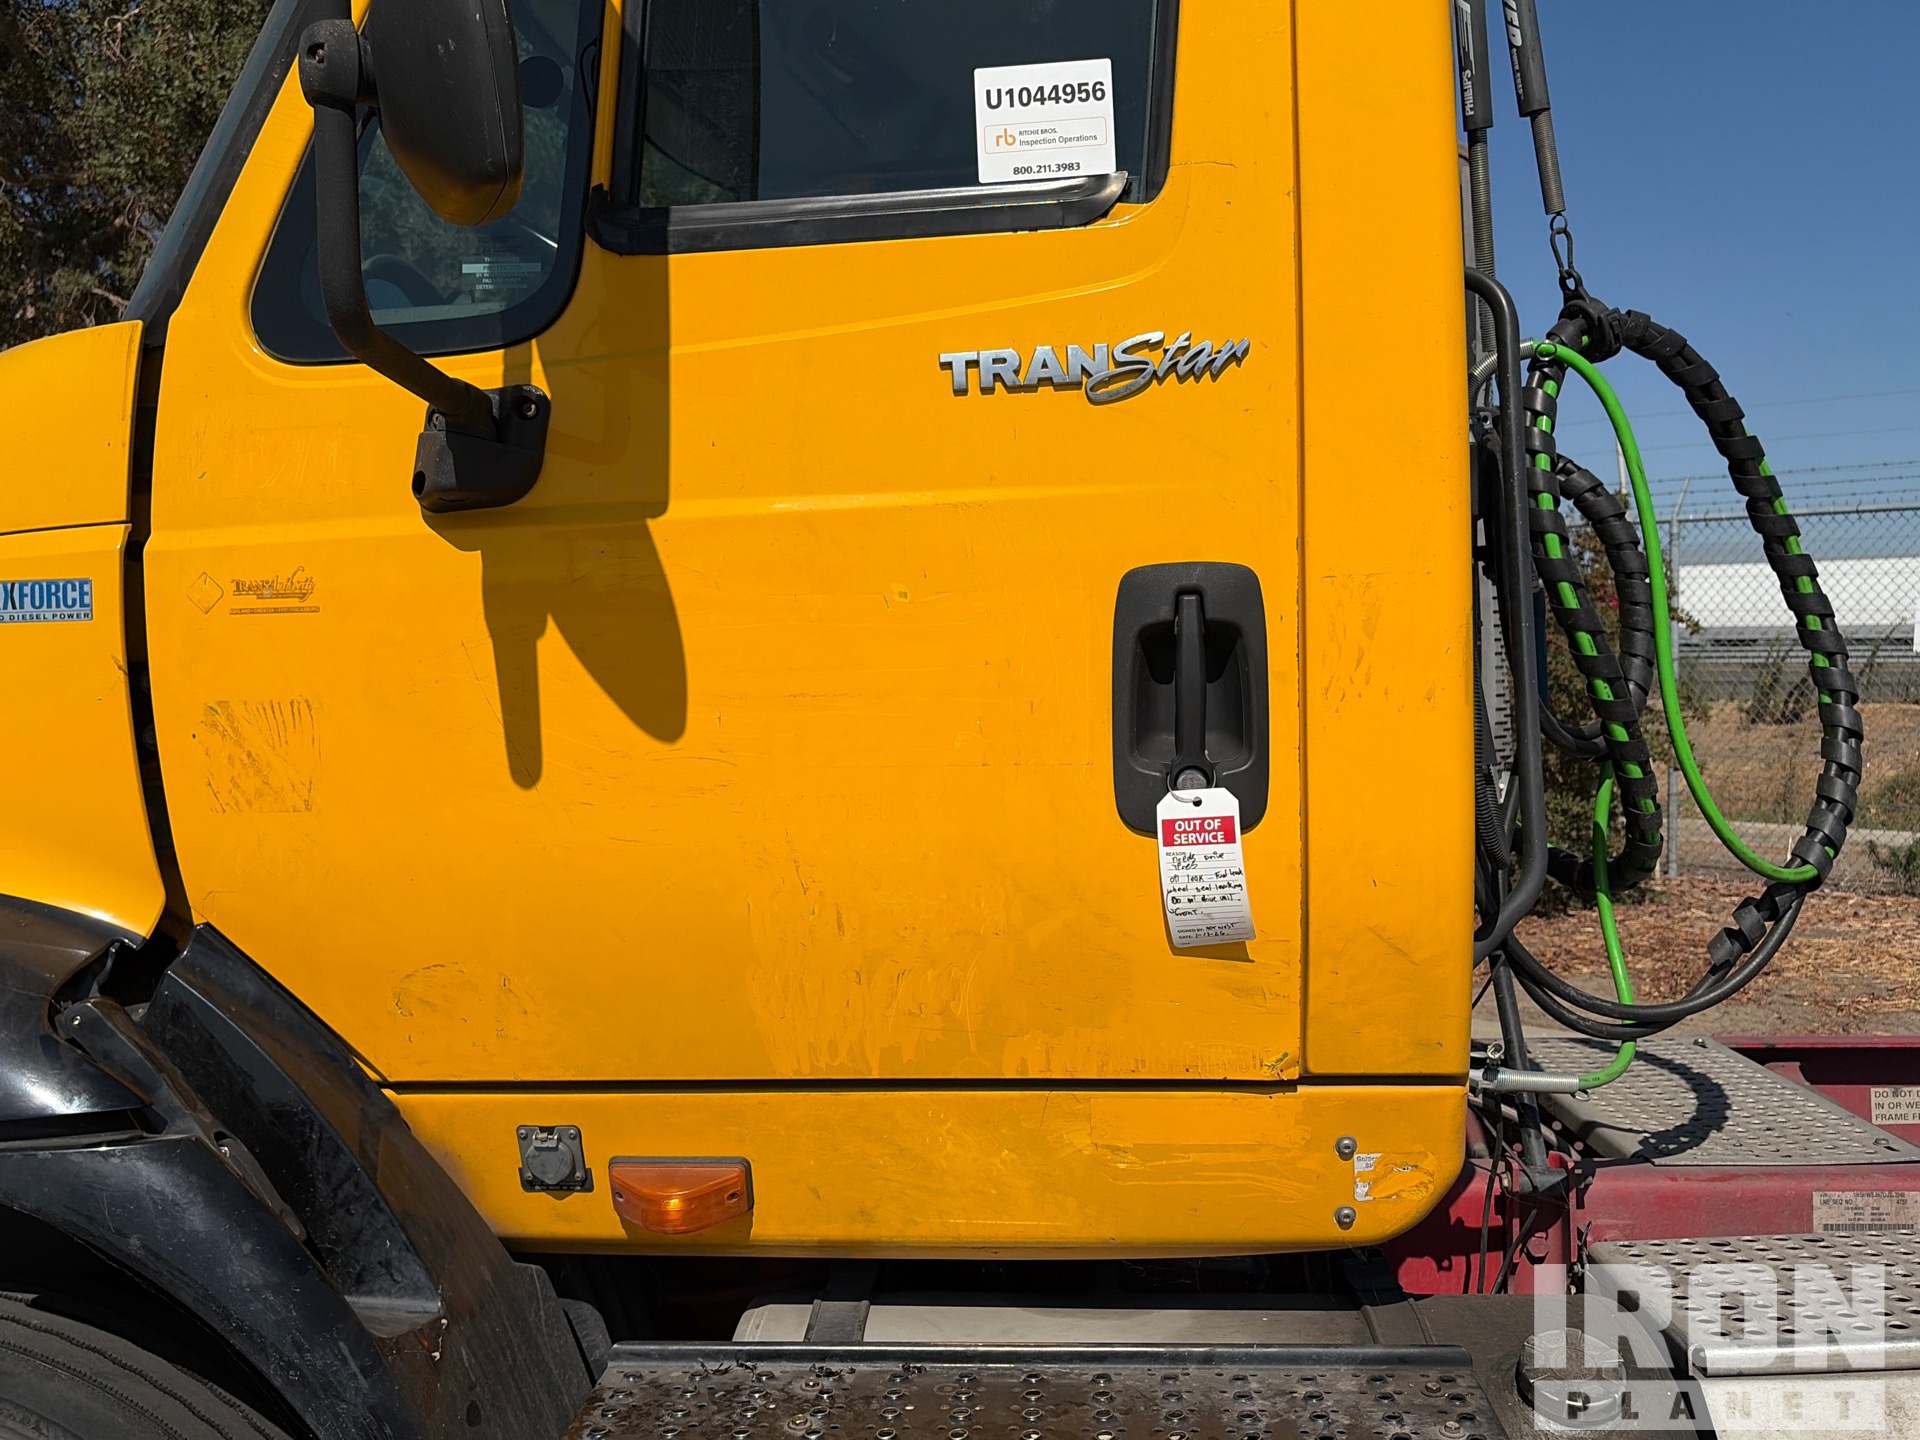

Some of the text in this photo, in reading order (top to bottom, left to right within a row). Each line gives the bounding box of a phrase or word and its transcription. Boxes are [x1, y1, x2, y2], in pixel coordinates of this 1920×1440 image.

[985, 81, 1106, 110] U1044956
[1462, 69, 1475, 116] PHILLIPS
[995, 128, 1097, 147] rb Inspection Operations
[1013, 162, 1081, 175] 800.211.3983
[0, 580, 91, 610] XFORCE
[52, 612, 90, 620] POWER
[1174, 819, 1222, 832] OUT OF
[1173, 831, 1225, 845] SERVICE
[1892, 1090, 1912, 1098] NOT
[1875, 1113, 1909, 1121] FRAME
